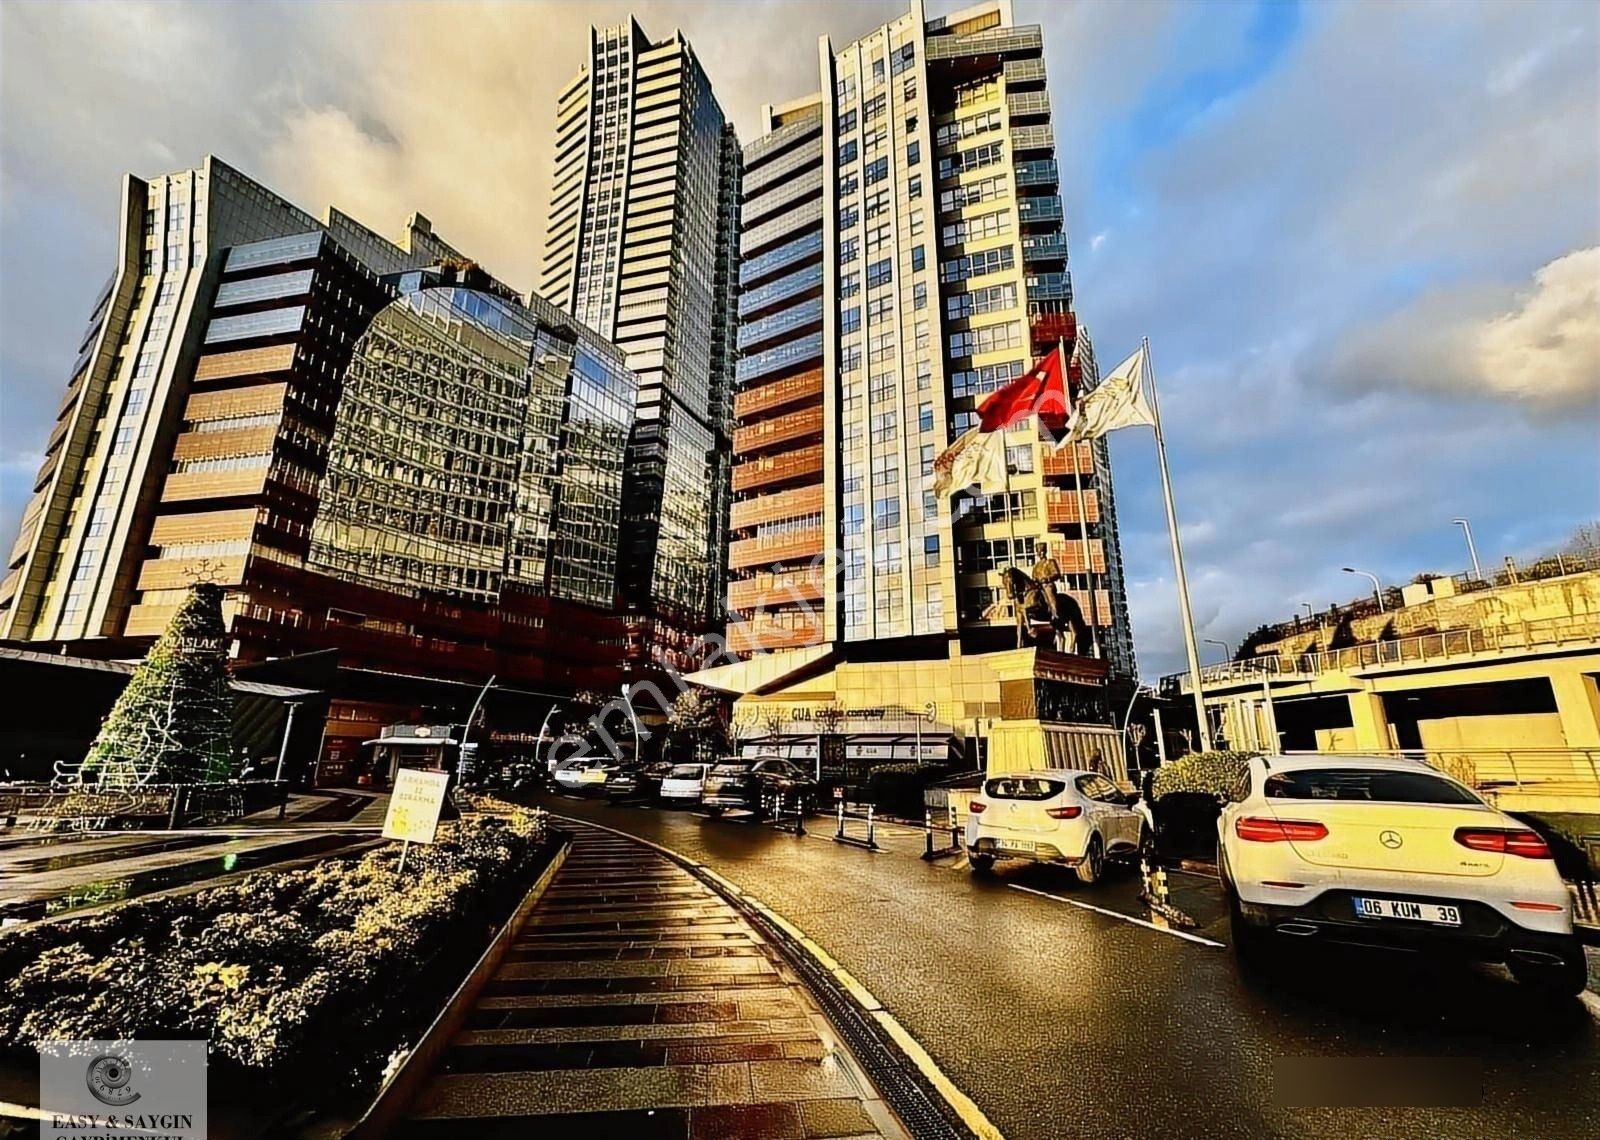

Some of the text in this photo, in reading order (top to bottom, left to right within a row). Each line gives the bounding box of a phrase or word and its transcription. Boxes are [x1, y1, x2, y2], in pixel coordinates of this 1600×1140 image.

[792, 708, 811, 721] GUA
[846, 709, 885, 721] company
[1363, 900, 1458, 922] 06 KUM 39
